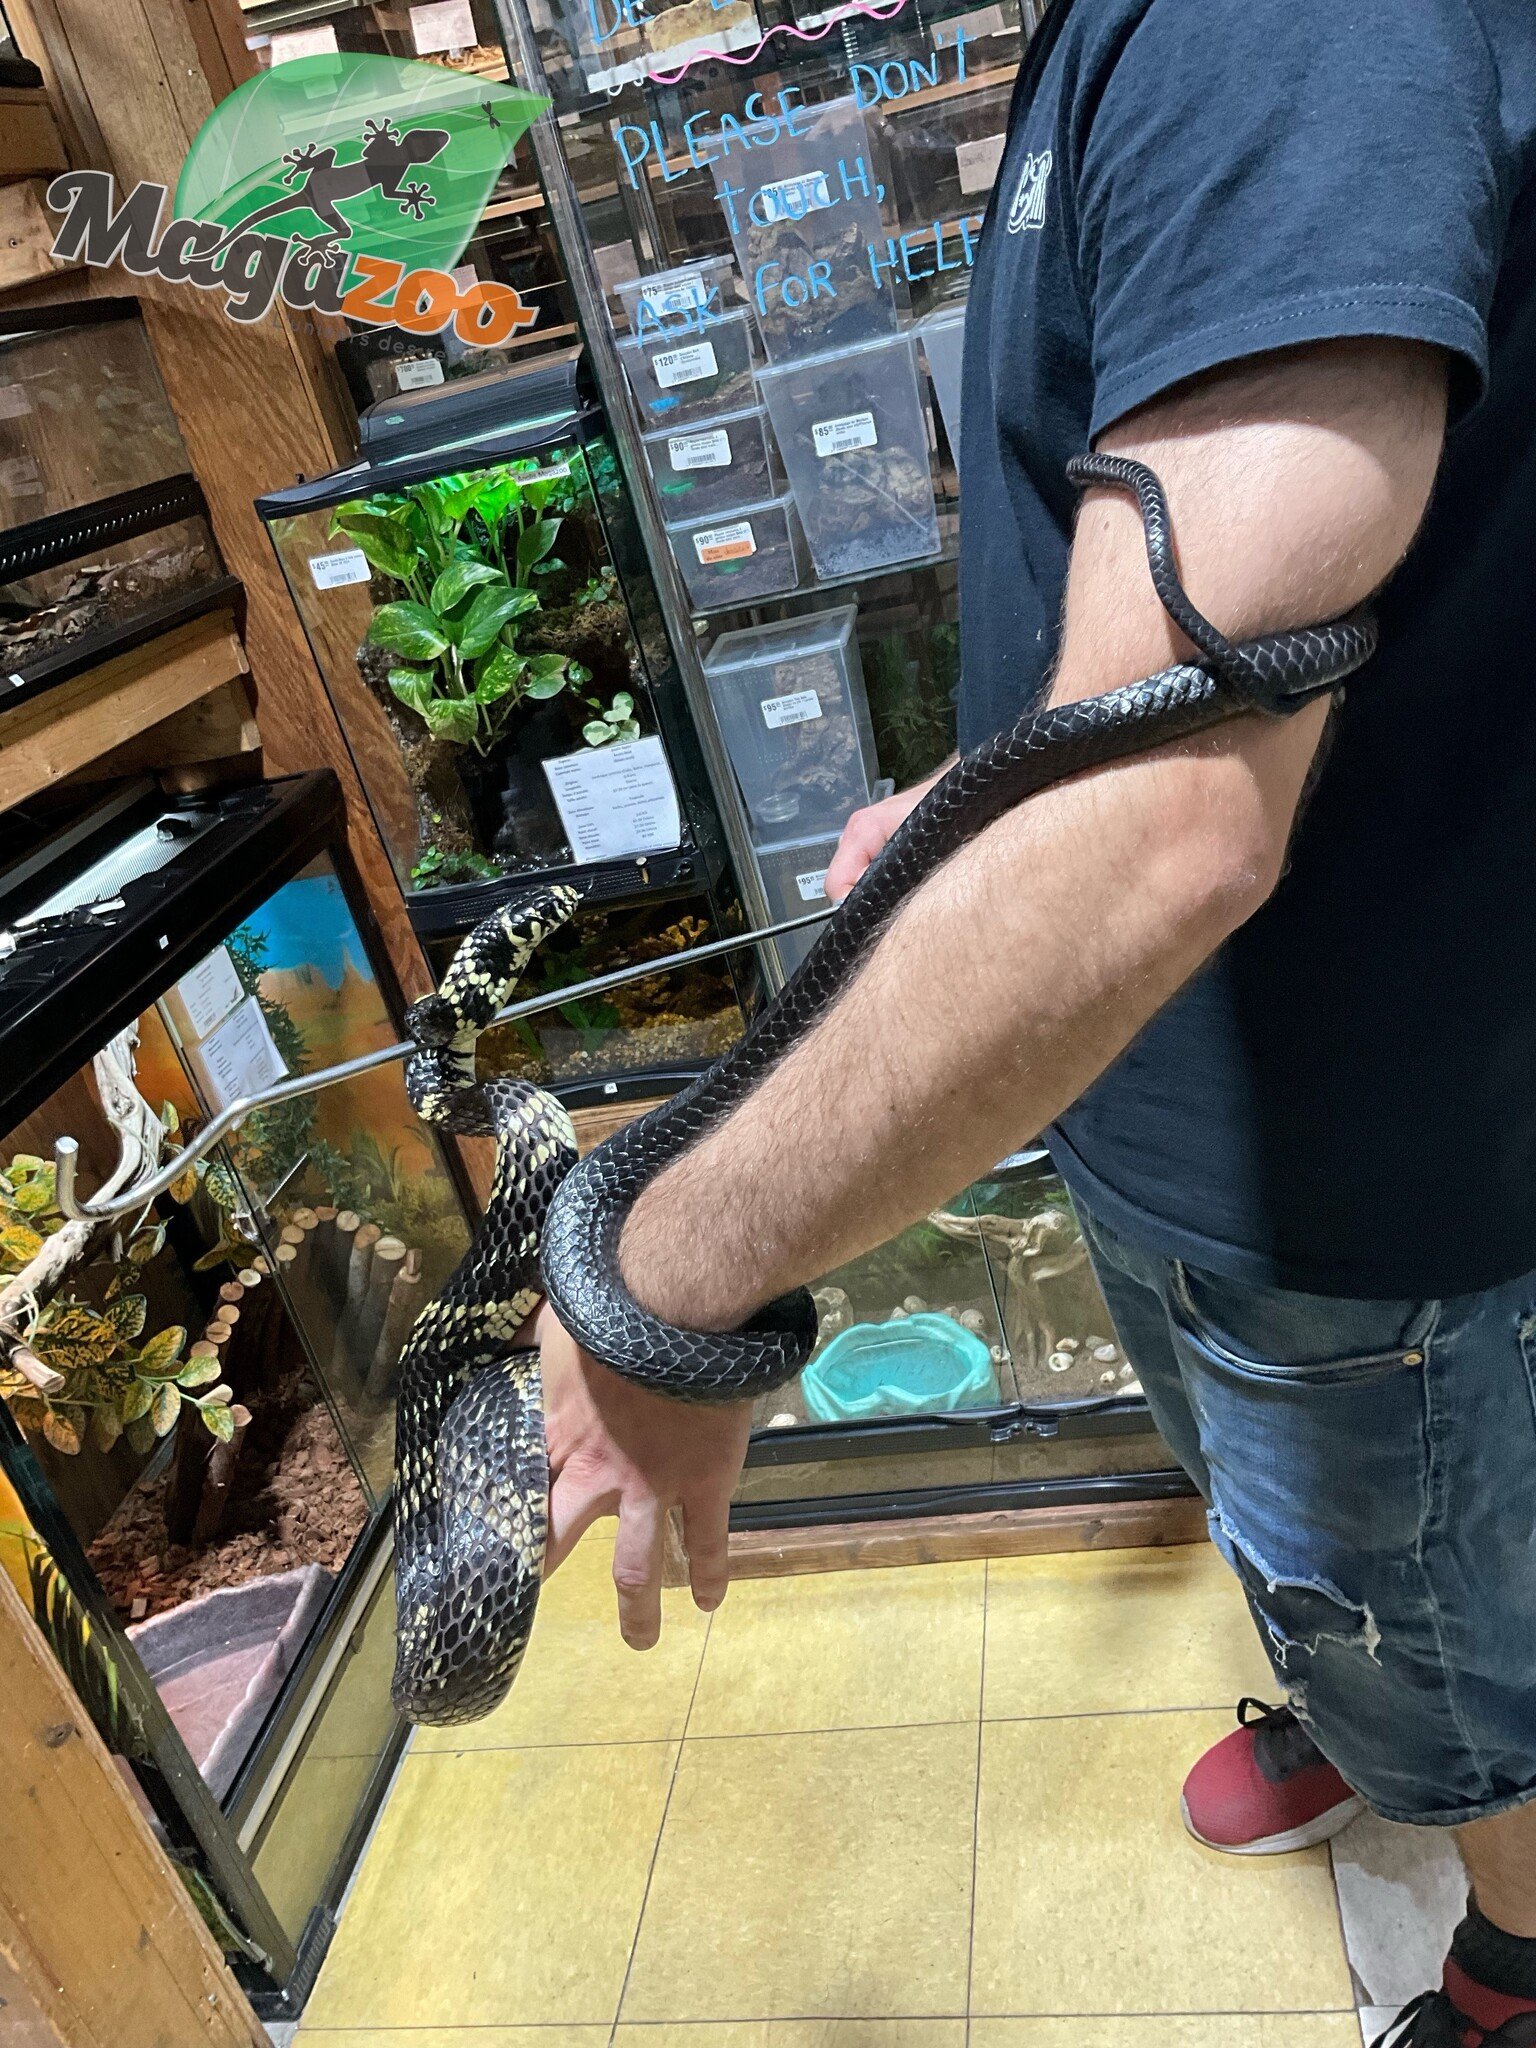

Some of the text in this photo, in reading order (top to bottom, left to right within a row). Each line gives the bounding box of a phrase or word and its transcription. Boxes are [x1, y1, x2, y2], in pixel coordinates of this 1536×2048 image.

[614, 24, 978, 190] PLEASE DON'T
[637, 286, 723, 349] ASK
[755, 258, 838, 317] FOR
